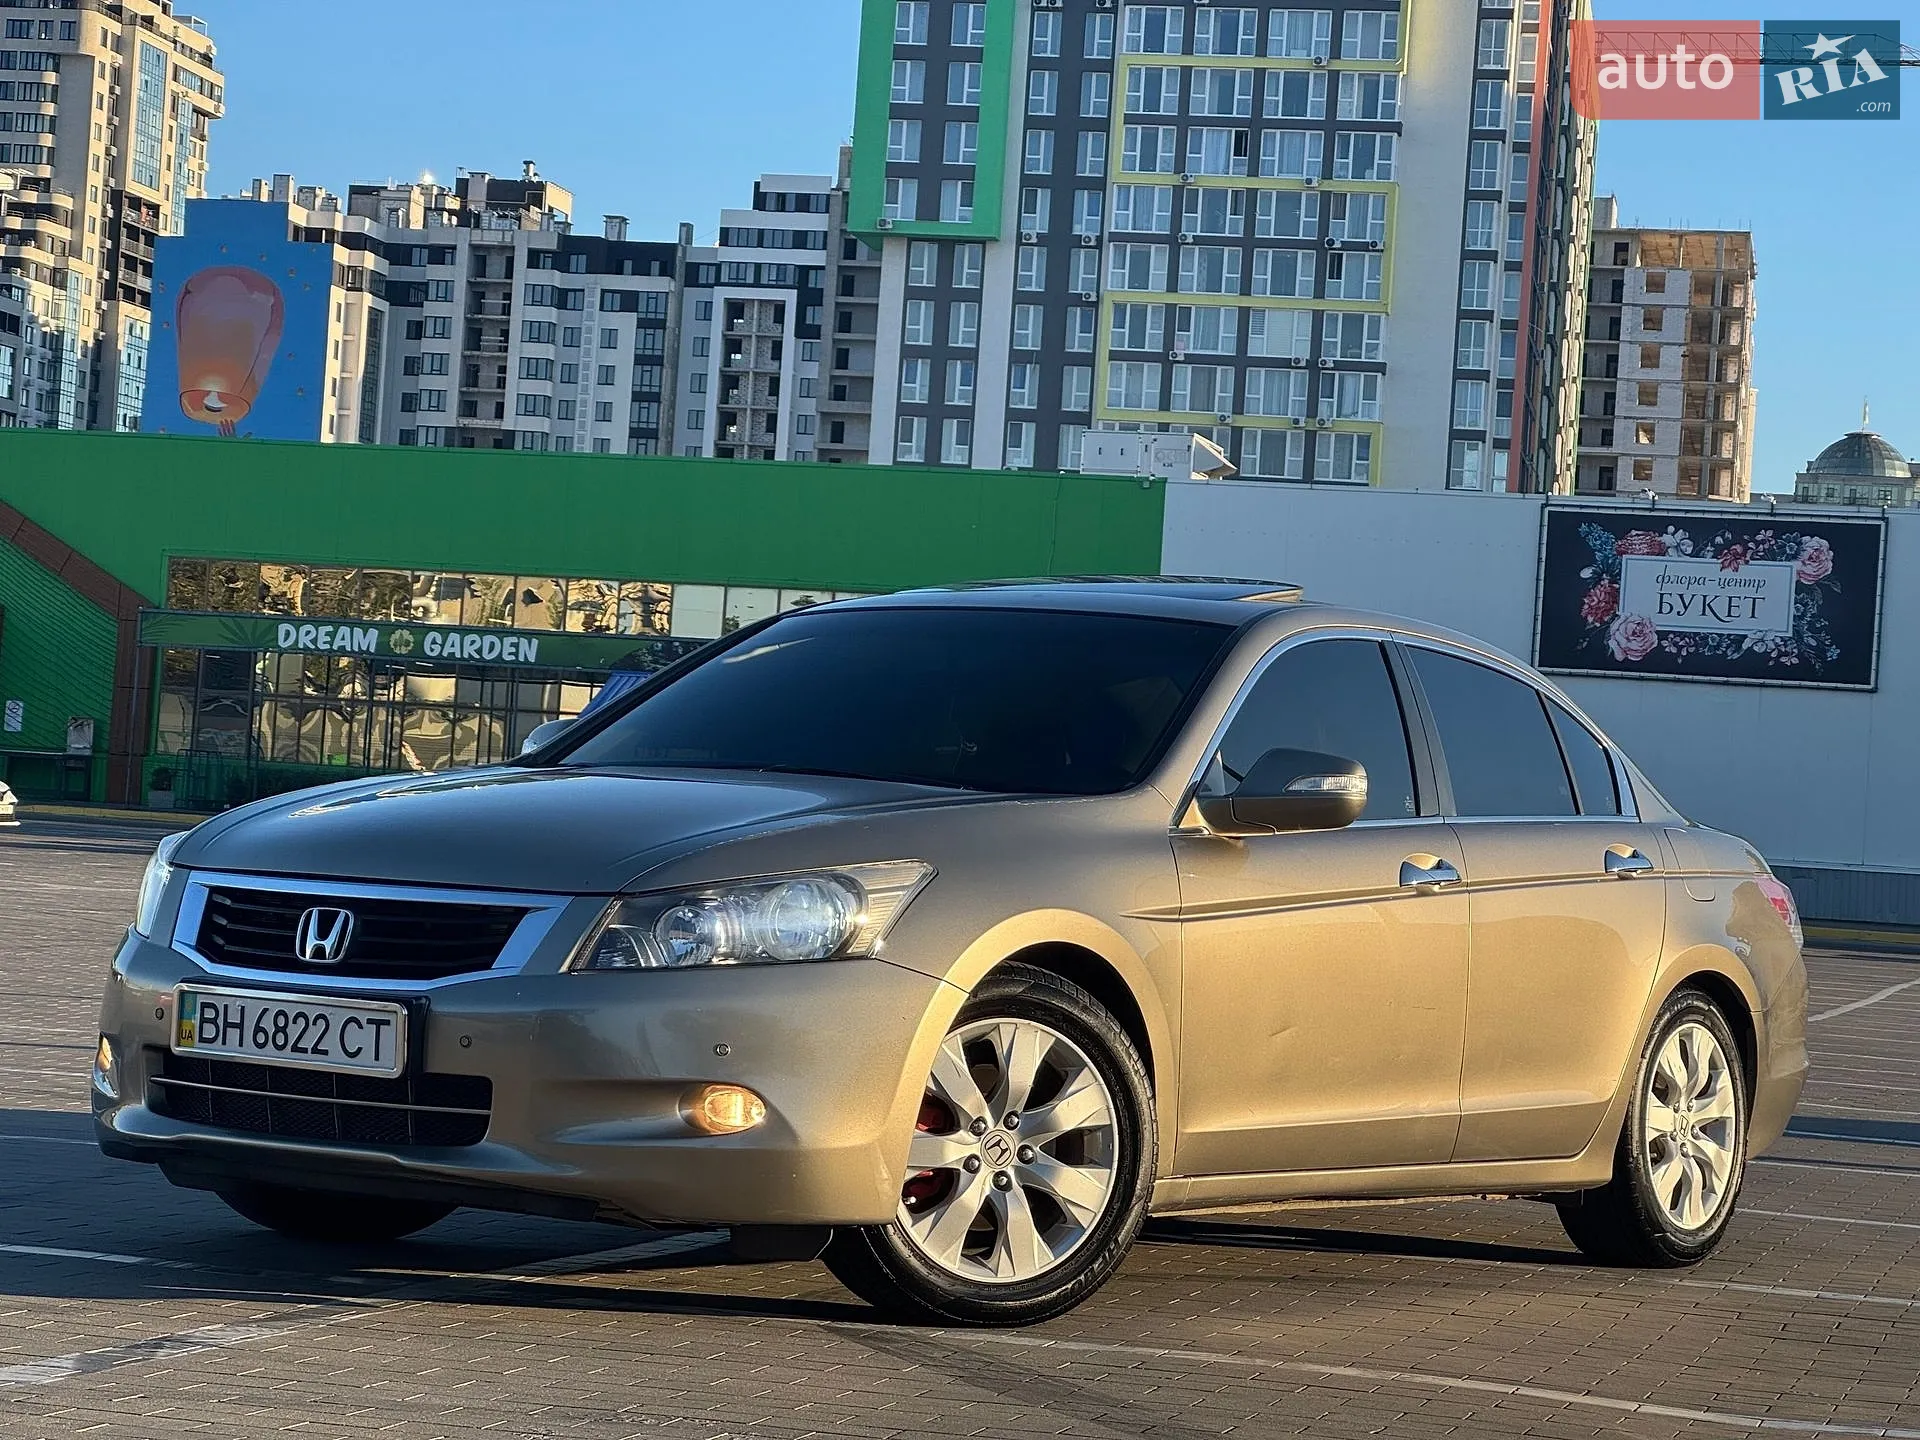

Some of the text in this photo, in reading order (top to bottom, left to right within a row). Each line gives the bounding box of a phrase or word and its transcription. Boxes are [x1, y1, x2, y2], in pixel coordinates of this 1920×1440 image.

[1655, 564, 1767, 594] флора-центр
[1656, 592, 1766, 623] БУКЕТ
[277, 623, 539, 662] DREAM GARDEN
[180, 1028, 194, 1041] UA
[198, 1001, 391, 1061] BH 6822 CT
